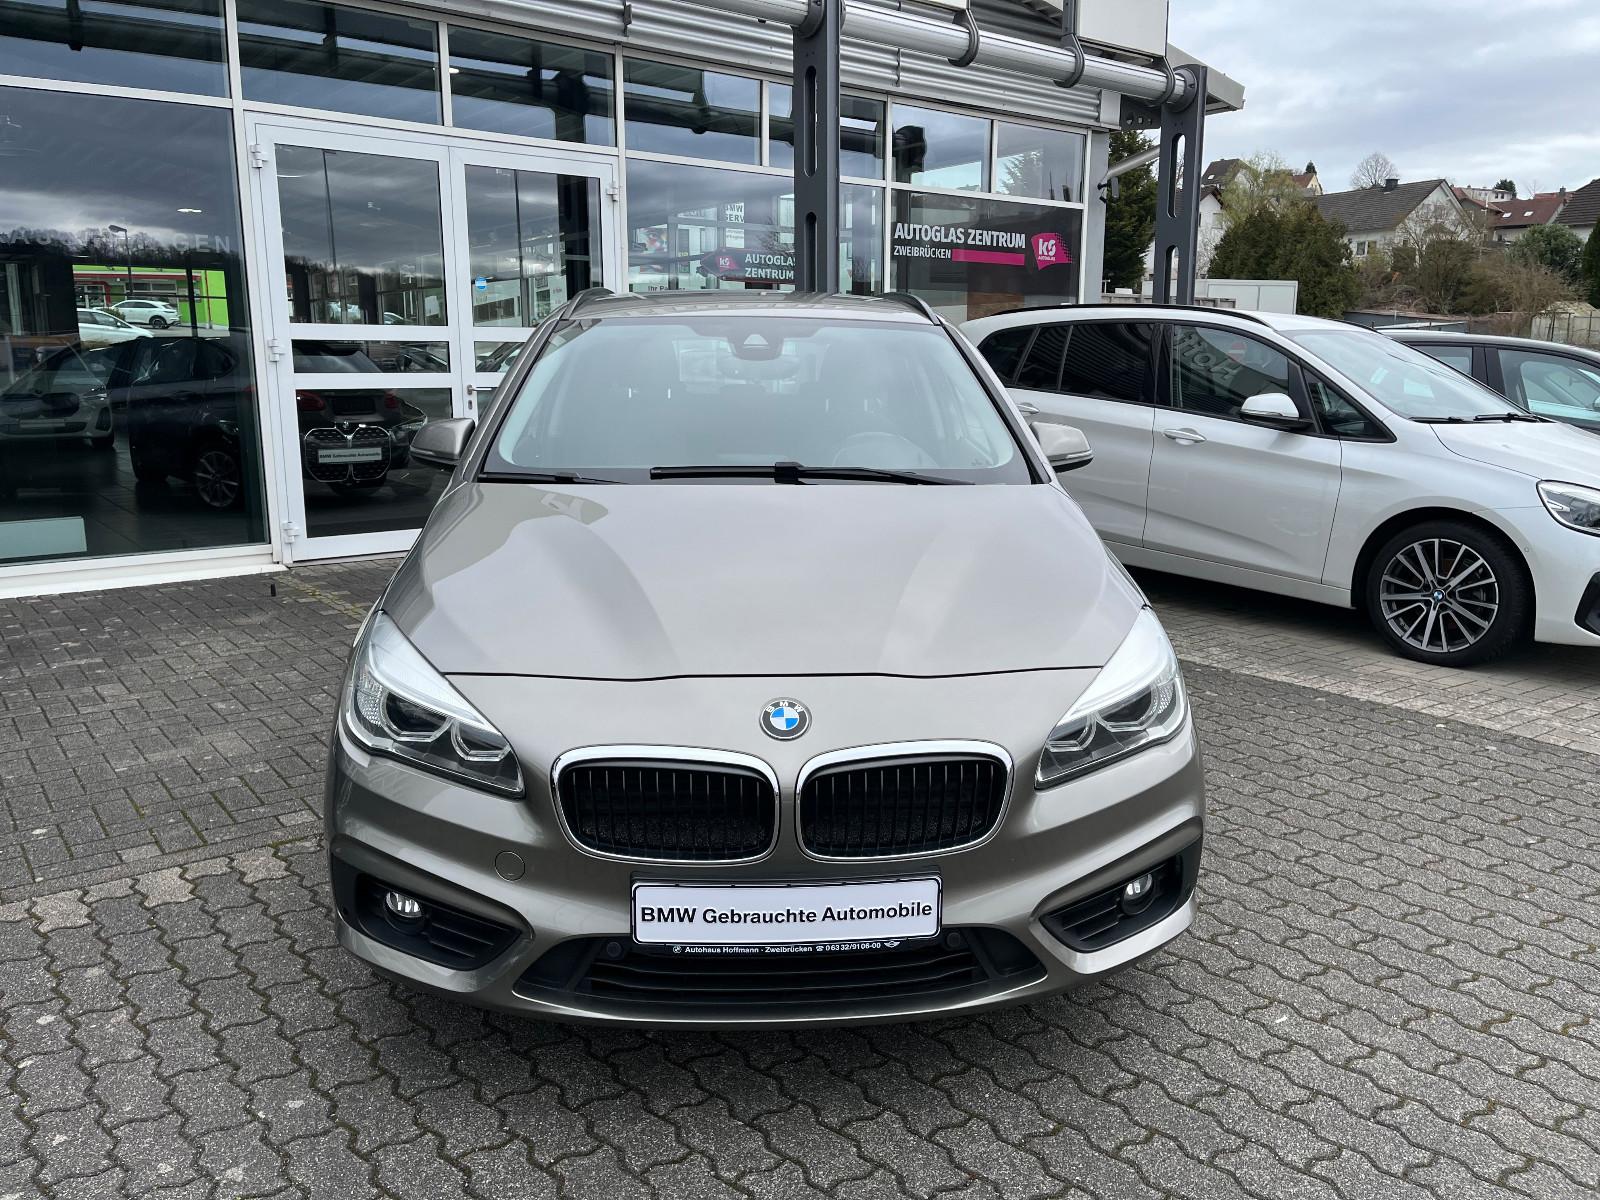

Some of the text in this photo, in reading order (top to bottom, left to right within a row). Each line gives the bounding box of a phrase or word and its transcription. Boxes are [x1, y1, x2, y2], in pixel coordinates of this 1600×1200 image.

[894, 222, 1026, 249] AUTOGLAS ZENTRUM
[893, 245, 951, 259] ZWEIBRÜCKEN
[744, 267, 794, 280] ZENTRUM
[765, 701, 805, 713] BMW
[641, 901, 933, 924] BMW Gebrauchte Automobile
[764, 945, 813, 953] Zweibrücken
